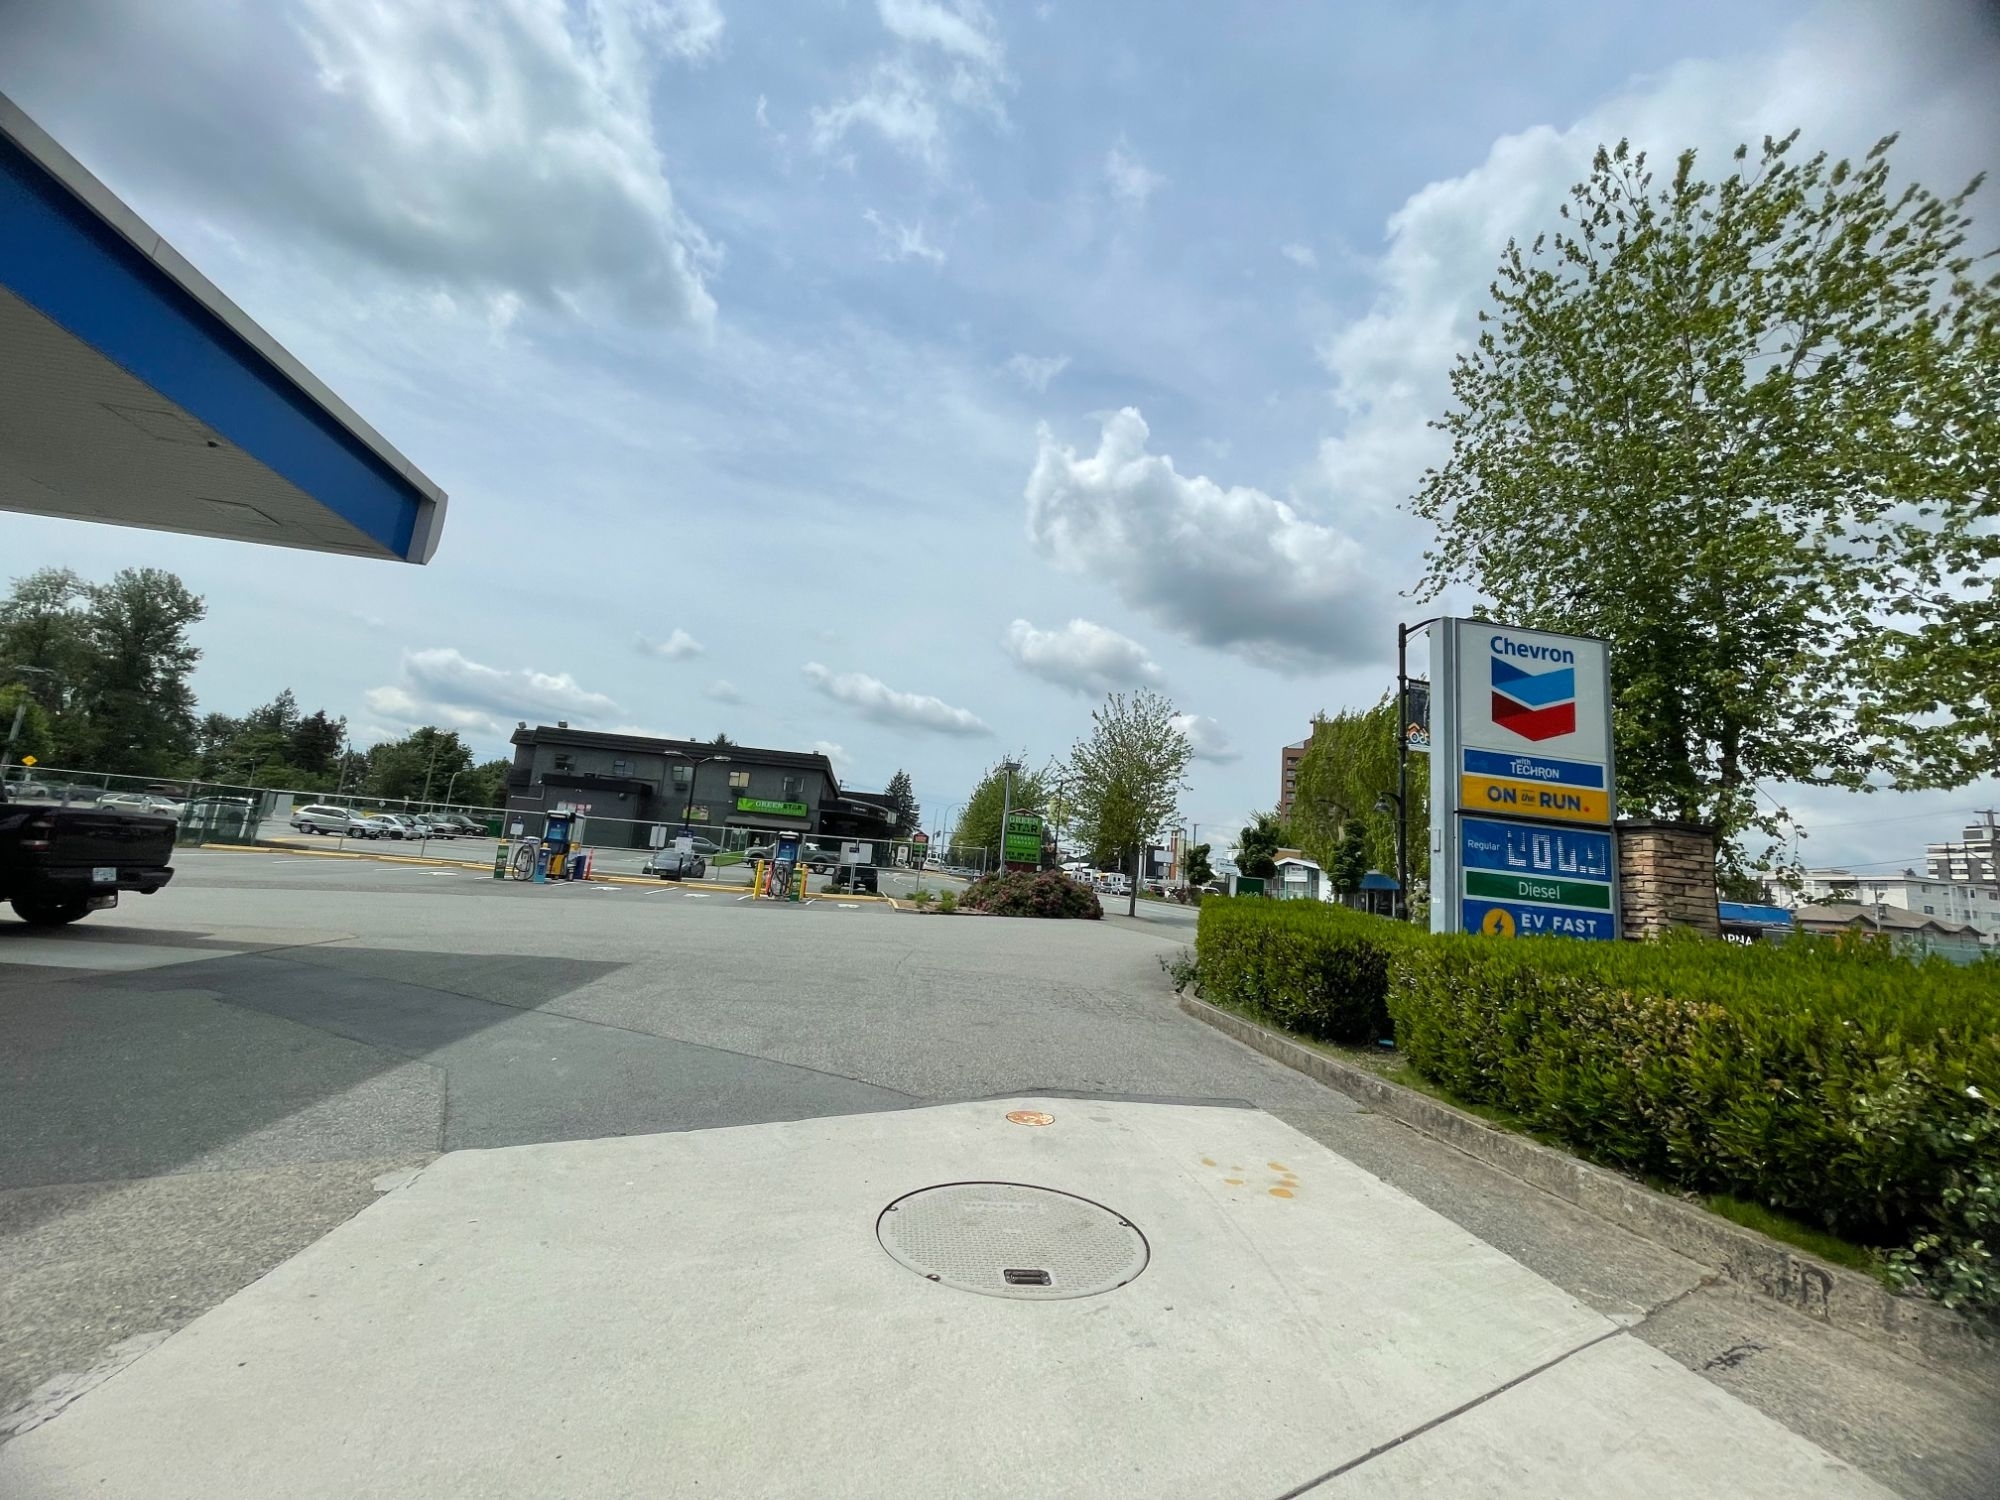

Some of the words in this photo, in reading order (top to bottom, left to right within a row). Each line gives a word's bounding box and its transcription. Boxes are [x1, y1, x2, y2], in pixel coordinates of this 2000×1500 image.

[1490, 636, 1575, 664] Chevron
[1509, 761, 1560, 780] TECHRON
[1515, 758, 1531, 767] with
[1487, 785, 1517, 804] ON
[1009, 822, 1038, 833] STAR
[1467, 839, 1500, 851] Regular
[1518, 881, 1561, 900] Diesel
[1521, 913, 1545, 929] EV
[1552, 916, 1597, 934] FAST
